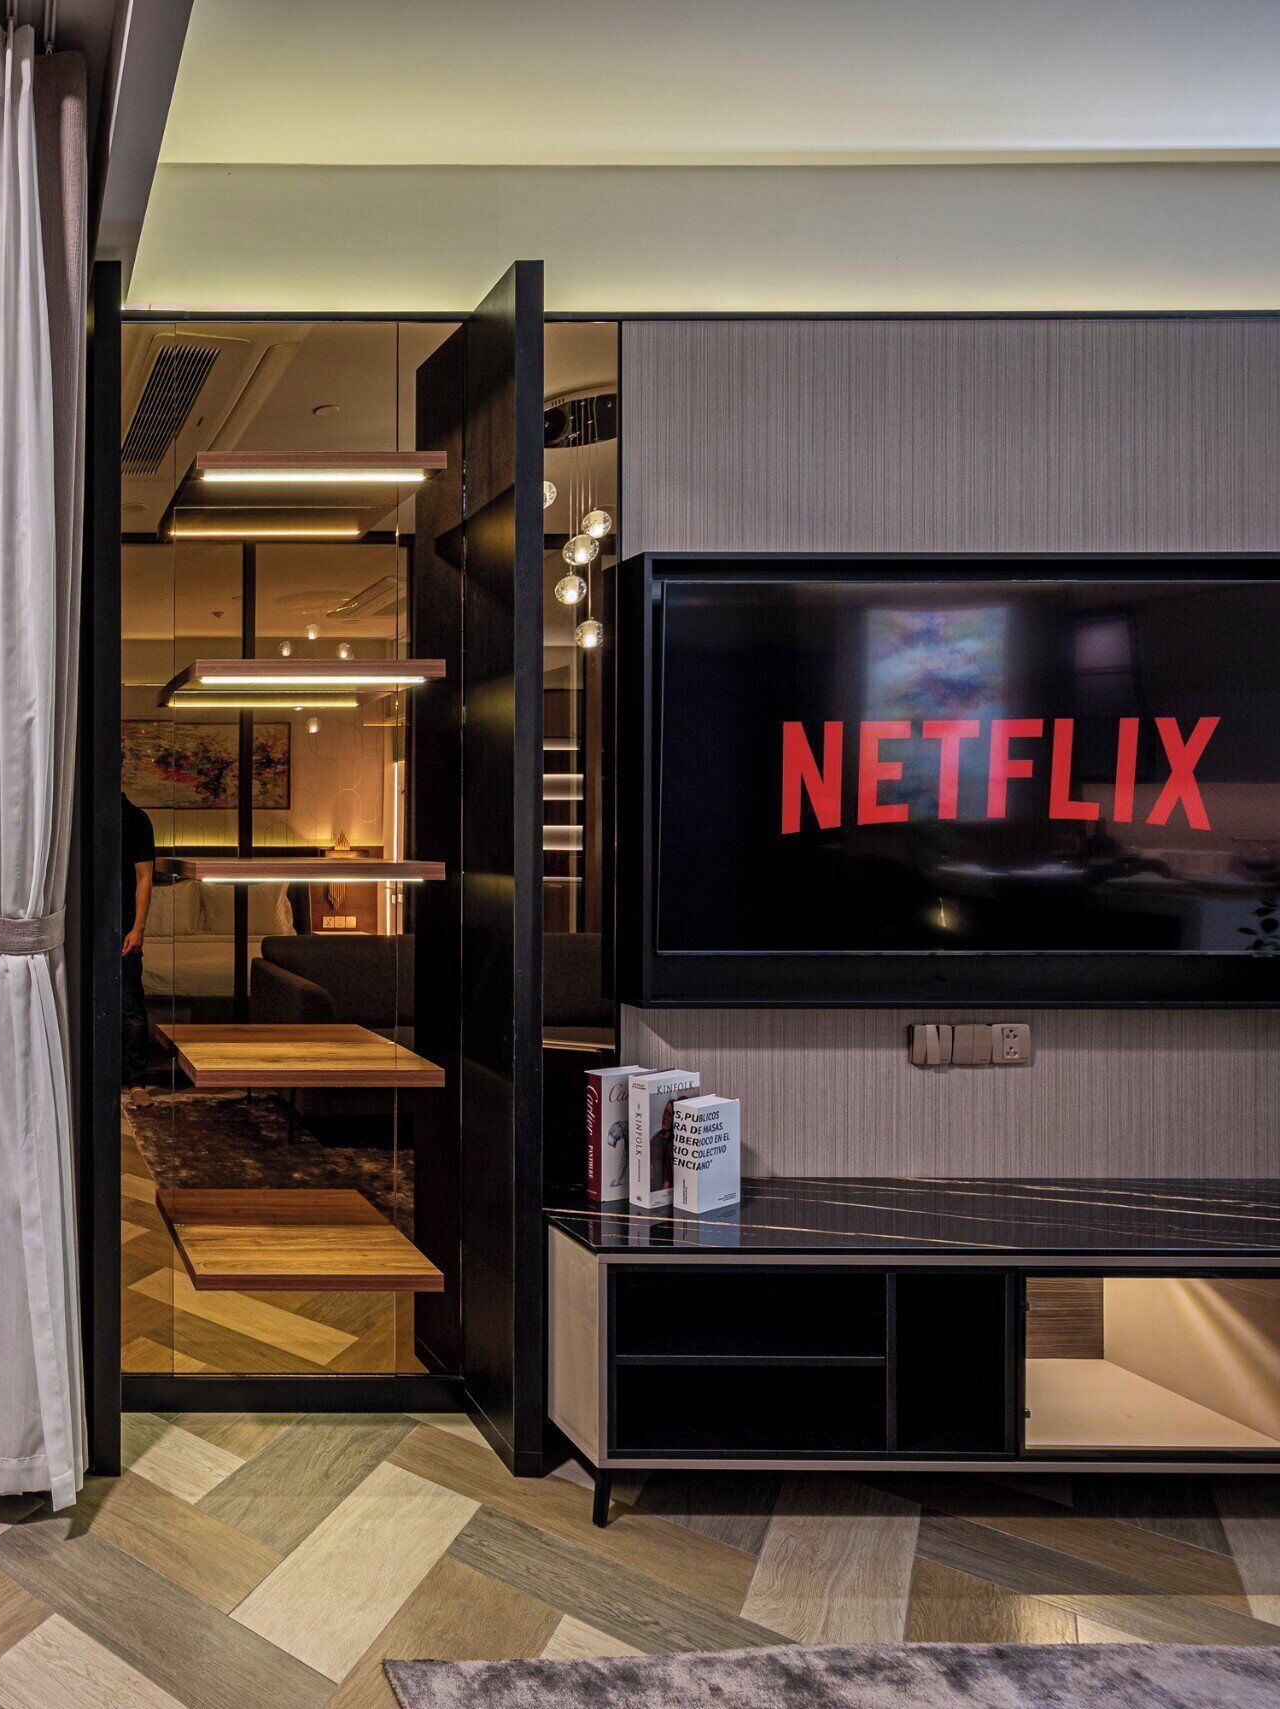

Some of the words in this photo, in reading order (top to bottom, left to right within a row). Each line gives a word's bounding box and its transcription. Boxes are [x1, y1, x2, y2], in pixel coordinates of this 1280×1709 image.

[782, 717, 1220, 834] NETFLIX
[657, 1081, 695, 1095] KINFOLK
[690, 1126, 702, 1135] DE
[691, 1145, 727, 1158] COLECTIVO
